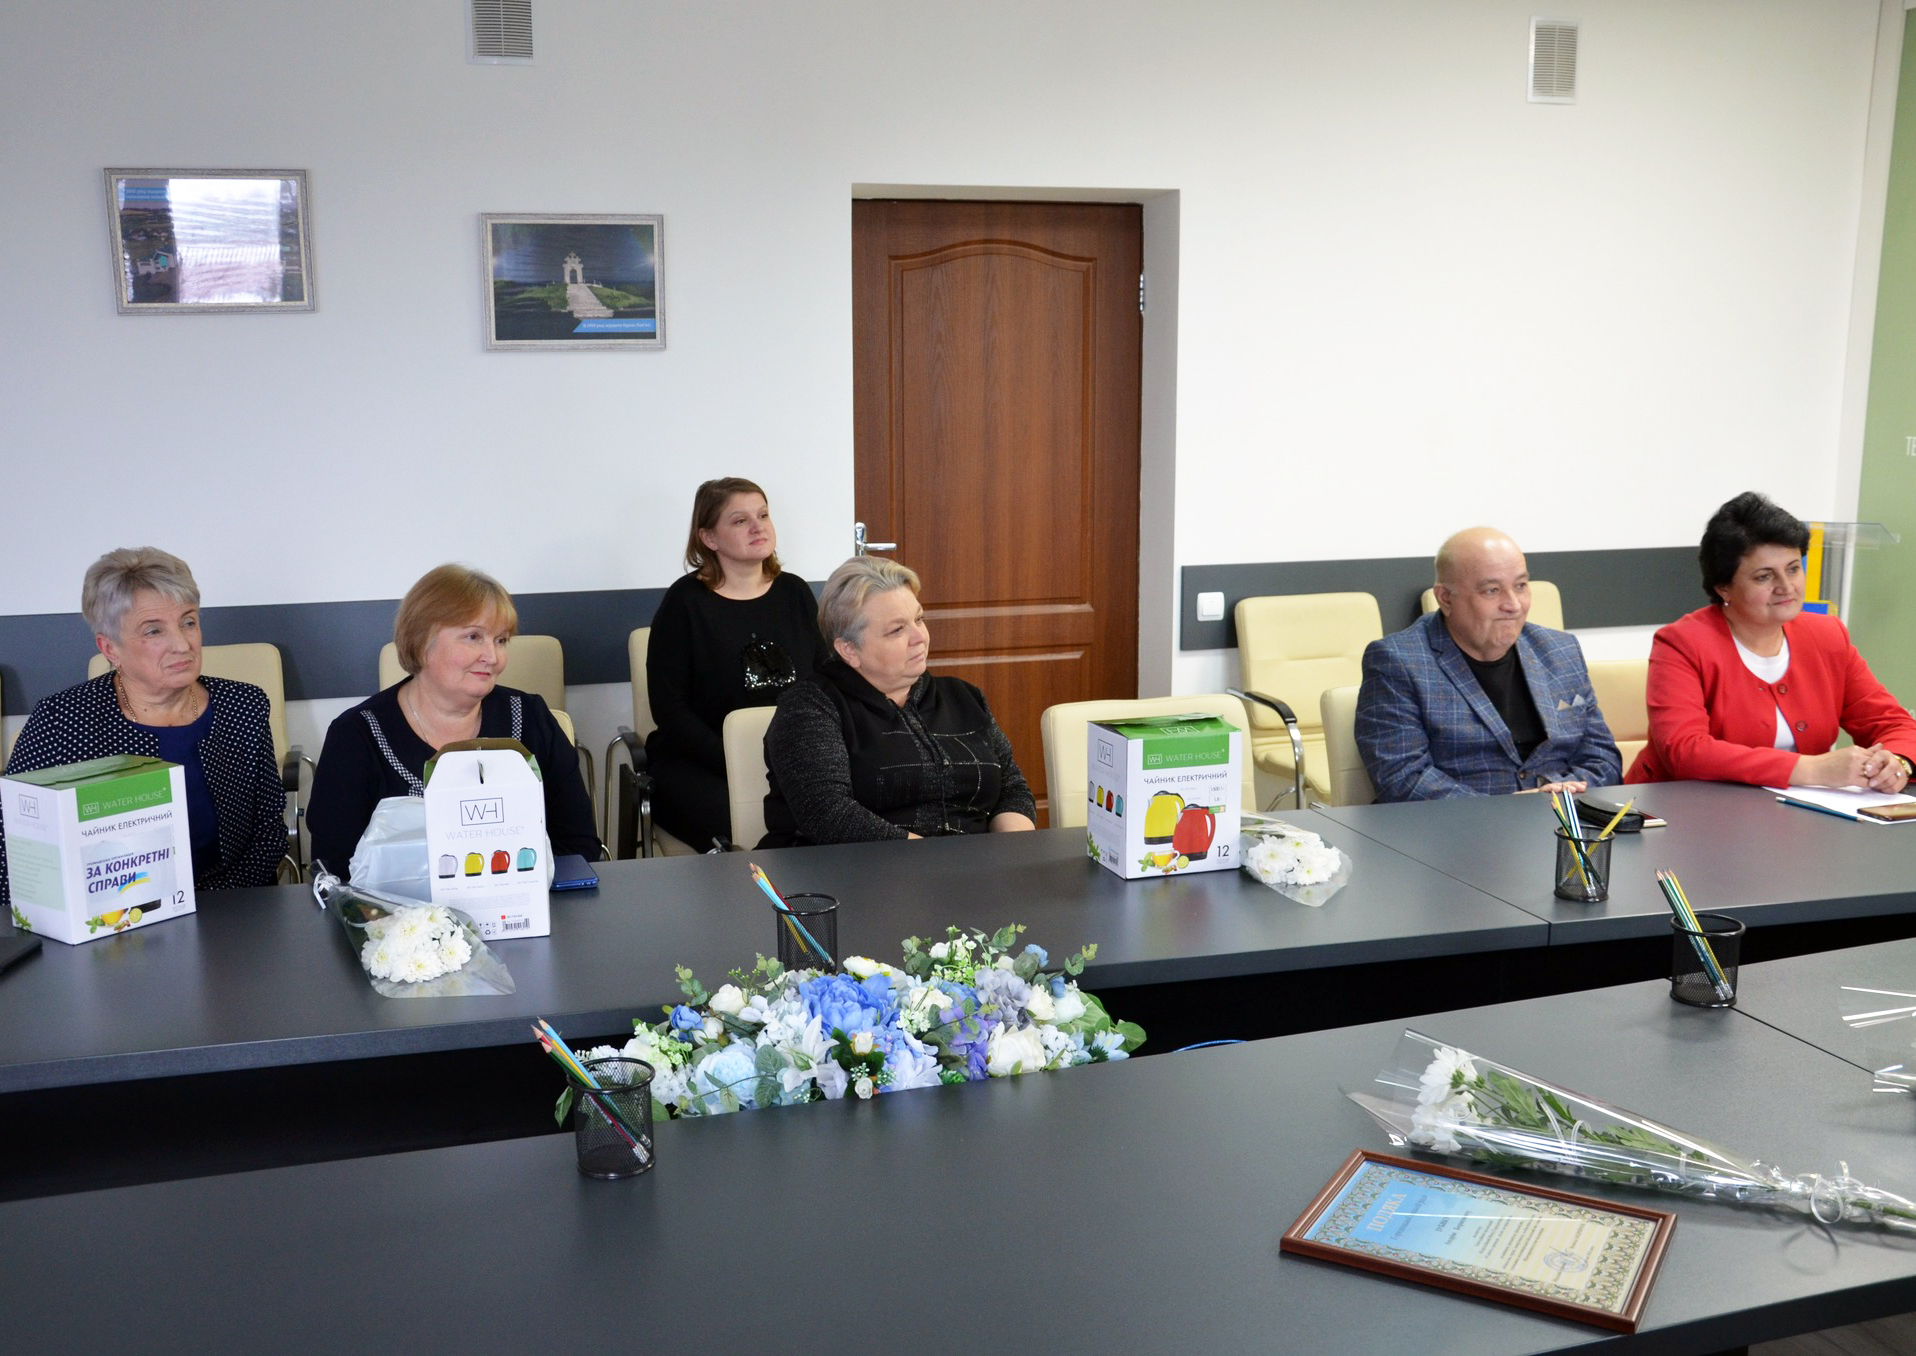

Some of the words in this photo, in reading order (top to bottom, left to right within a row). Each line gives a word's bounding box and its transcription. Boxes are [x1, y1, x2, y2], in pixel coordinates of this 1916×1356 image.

[1149, 755, 1161, 764] WH
[1166, 753, 1194, 763] WATER
[1144, 773, 1176, 784] ЧАЙНИК
[1177, 770, 1228, 783] ЕЛЕКТРИЧНИЙ
[20, 799, 38, 816] WH
[84, 803, 99, 815] WH
[102, 796, 133, 810] WATER
[463, 800, 500, 823] WH
[81, 823, 117, 838] ЧАЙНИК
[118, 810, 173, 831] ЕЛЕКТРИЧНИЙ
[445, 829, 482, 841] WATER
[1216, 844, 1230, 857] 12
[86, 866, 102, 880] ЗА
[105, 848, 170, 875] КОНКРЕТНІ
[88, 871, 137, 894] СПРАВИ
[172, 890, 185, 905] 12
[1366, 1193, 1407, 1232] ПОДЯКА
